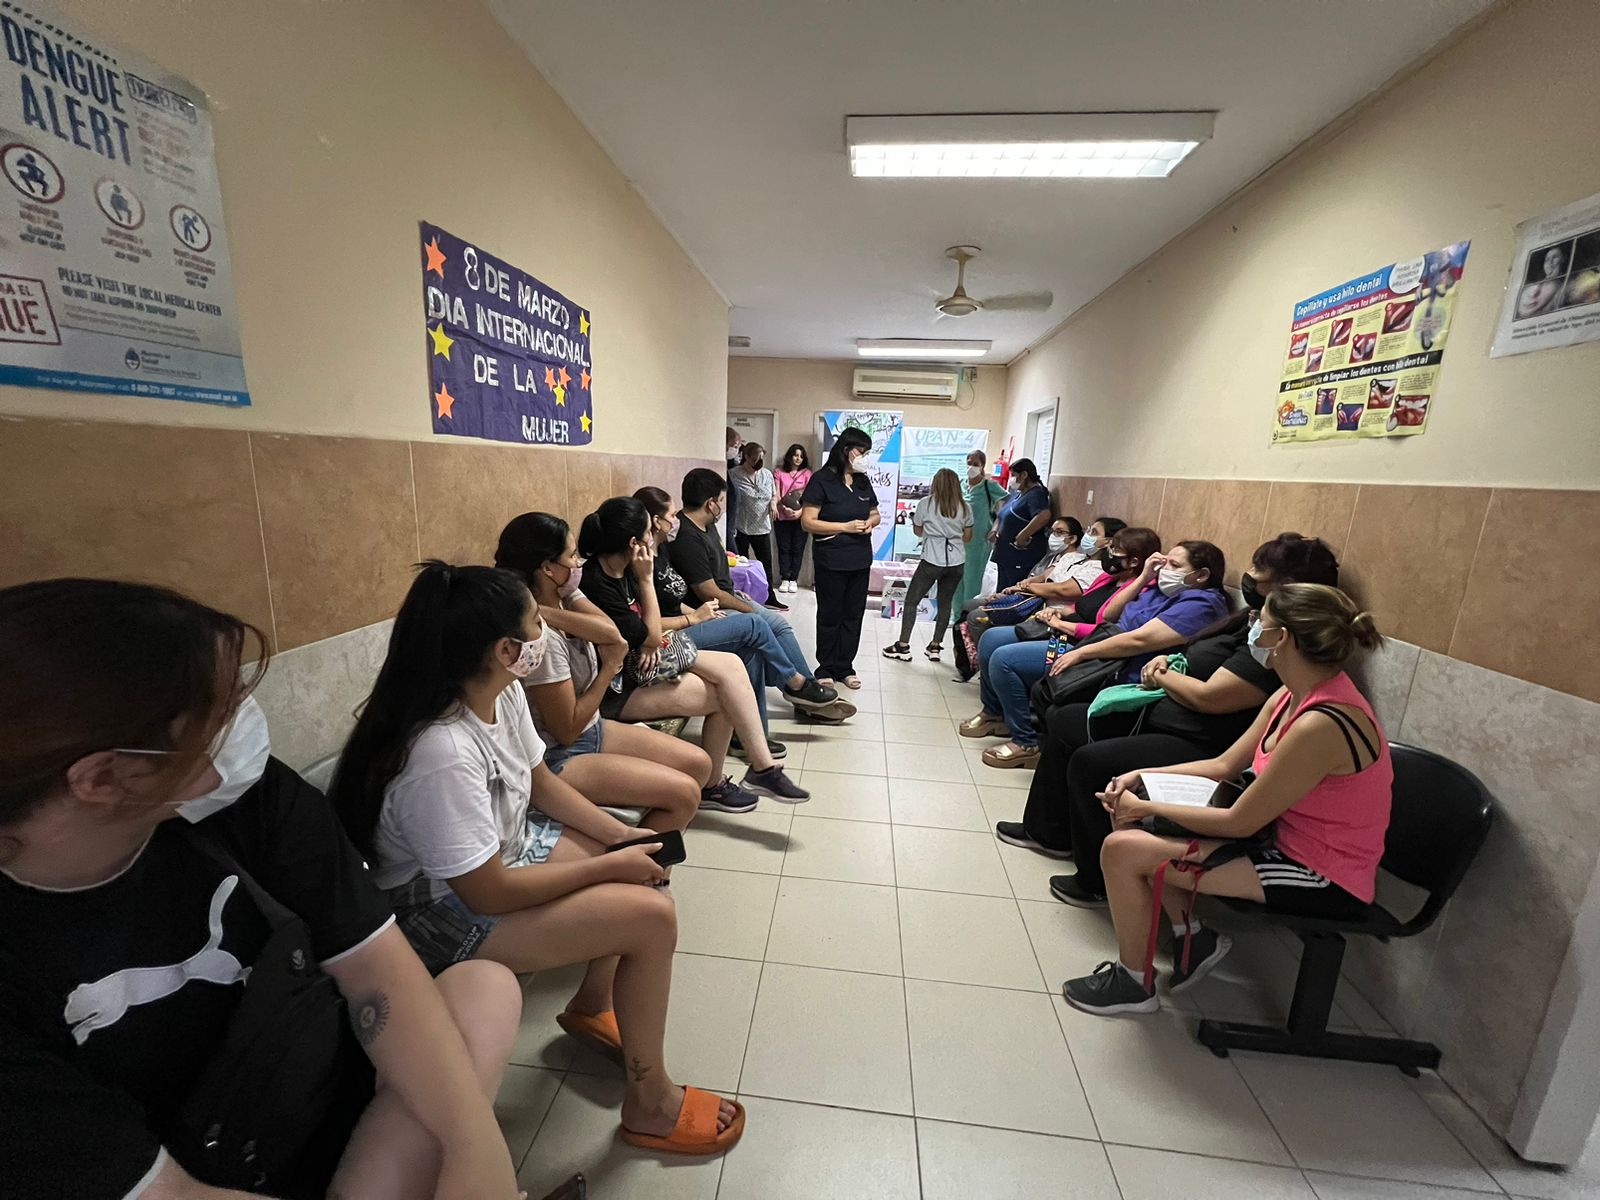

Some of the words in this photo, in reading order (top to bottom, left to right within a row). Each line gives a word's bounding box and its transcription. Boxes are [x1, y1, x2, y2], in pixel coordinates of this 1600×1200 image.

[0, 13, 125, 113] DENGUE
[21, 74, 131, 166] ALERT
[18, 285, 34, 296] EL
[58, 266, 94, 287] PLEASE
[95, 275, 121, 293] VISIT
[122, 282, 137, 297] THE
[139, 285, 163, 303] LOCAL
[164, 291, 196, 311] MEDICAL
[196, 300, 222, 316] CENTER
[463, 247, 480, 291] 8
[485, 262, 511, 302] DE
[518, 281, 570, 330] MARZO
[1328, 292, 1341, 303] usa
[1356, 273, 1383, 293] dental
[0, 298, 46, 335] UE
[427, 286, 469, 330] DIA
[475, 303, 590, 367] INTERNACIONAL
[474, 354, 499, 386] DE
[513, 363, 537, 394] LA
[1350, 369, 1359, 378] los
[1382, 363, 1395, 372] con
[1404, 354, 1429, 367] dental
[522, 415, 569, 443] MUJER
[915, 430, 943, 442] UPA
[965, 431, 975, 443] 4
